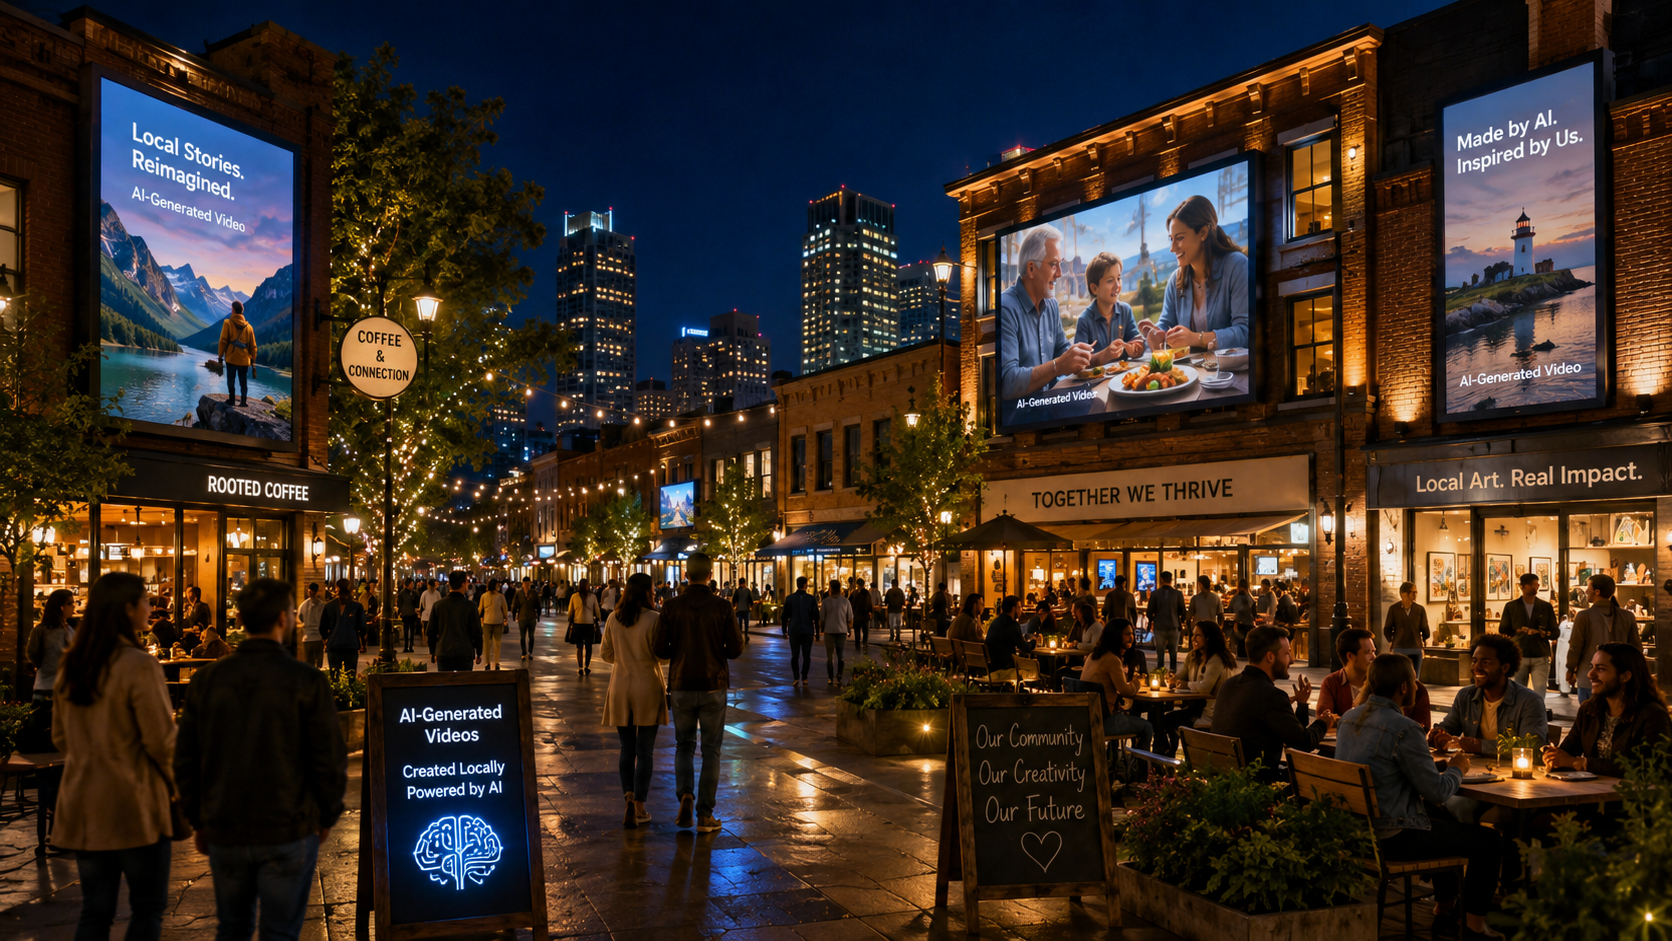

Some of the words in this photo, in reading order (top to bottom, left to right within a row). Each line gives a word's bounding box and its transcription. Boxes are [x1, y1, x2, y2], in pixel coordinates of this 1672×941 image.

[1457, 126, 1504, 152] Made
[1508, 120, 1530, 138] by
[1533, 109, 1558, 130] AI.
[132, 122, 179, 156] Local
[184, 142, 245, 180] Stories.
[1457, 141, 1525, 175] Inspired
[1529, 138, 1552, 157] by
[1555, 128, 1584, 147] Us.
[132, 148, 235, 201] Reimagined.
[131, 186, 212, 222] AI-Generated
[214, 211, 246, 233] Video
[357, 330, 402, 348] COFFEE
[375, 349, 385, 363] &
[348, 364, 410, 382] CONNECTION
[1459, 365, 1541, 388] AI-Generated
[1544, 362, 1582, 377] Video
[1016, 392, 1071, 409] AI-Generated
[207, 475, 261, 497] ROOTED
[264, 482, 309, 502] COFFEE
[1416, 471, 1464, 494] Local
[1469, 470, 1505, 490] Art.
[1511, 465, 1554, 488] Real
[1560, 460, 1644, 488] Impact.
[1031, 486, 1121, 509] TOGETHER
[1126, 484, 1156, 503] WE
[1161, 478, 1234, 501] THRIVE
[399, 703, 503, 724] AI-Generated
[424, 727, 480, 744] Videos
[976, 724, 1004, 749] Our
[1009, 722, 1083, 756] Community
[402, 762, 456, 779] Created
[459, 759, 505, 777] Locally
[979, 759, 1008, 786] Our
[1014, 758, 1086, 793] Creativity
[406, 782, 466, 800] Powered
[468, 782, 486, 798] by
[488, 780, 503, 794] AI
[985, 796, 1019, 824] Our
[1025, 794, 1086, 822] Future
